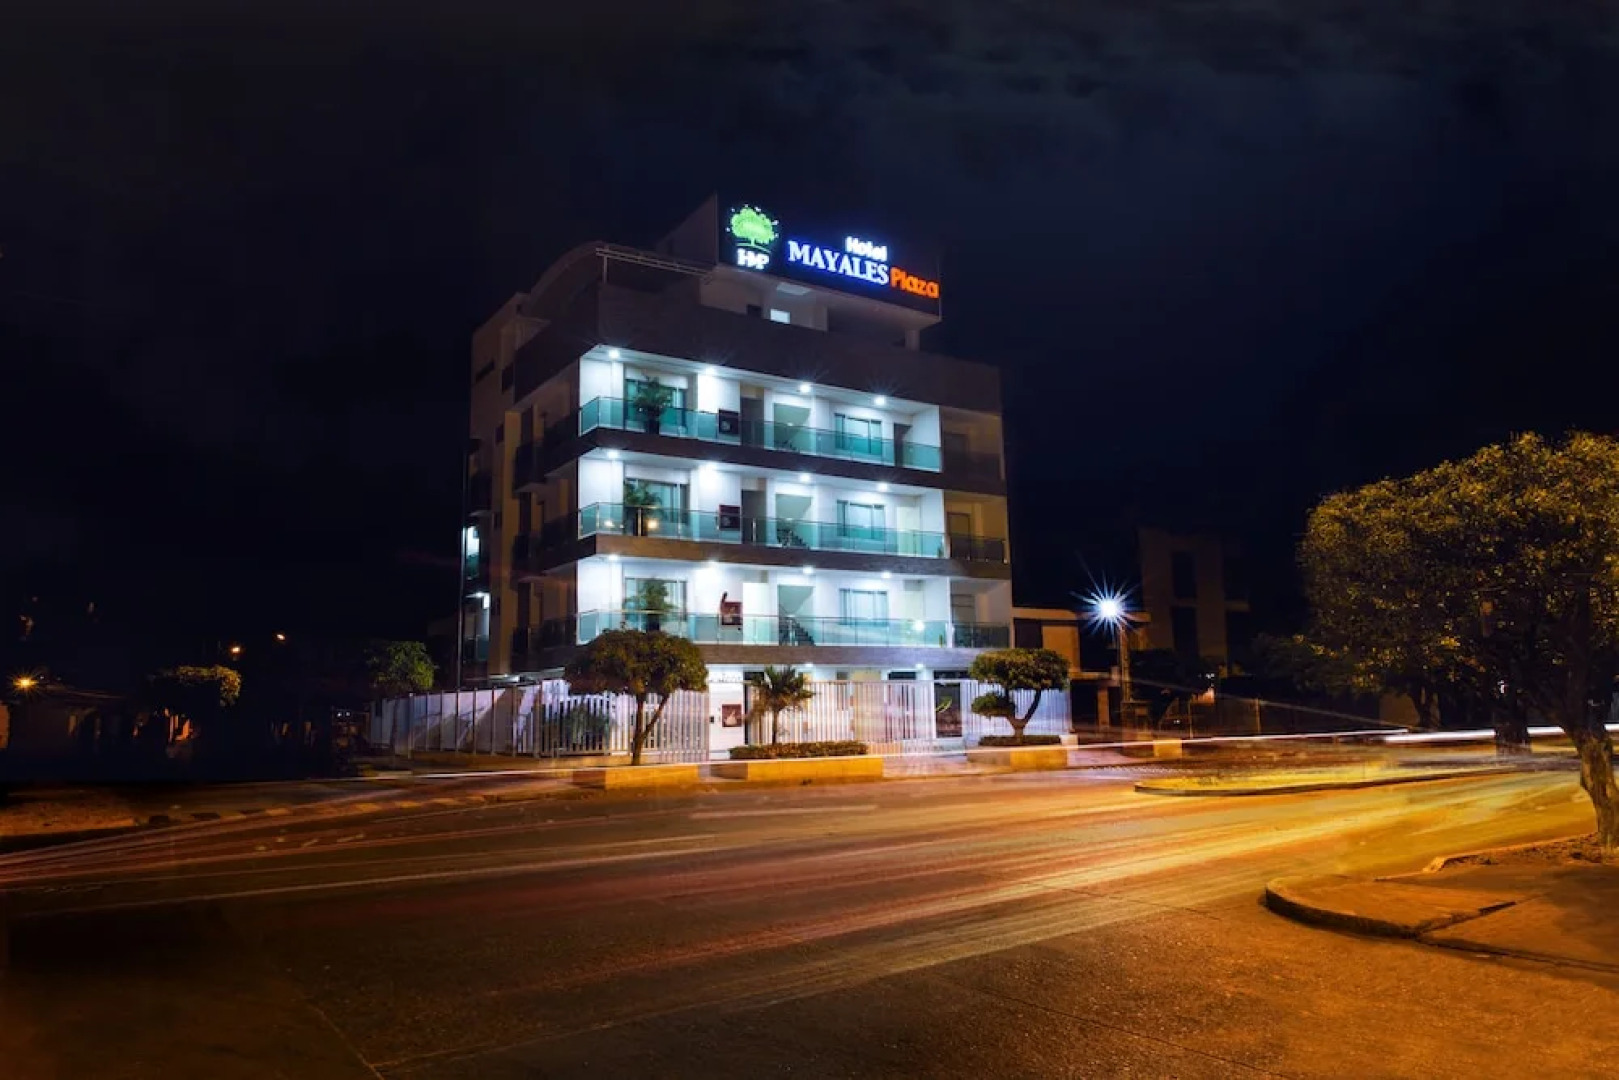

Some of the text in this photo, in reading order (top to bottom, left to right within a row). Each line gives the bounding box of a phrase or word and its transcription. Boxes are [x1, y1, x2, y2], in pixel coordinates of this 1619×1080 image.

[787, 240, 940, 299] MAYALES Plaza
[845, 236, 887, 262] Hotel
